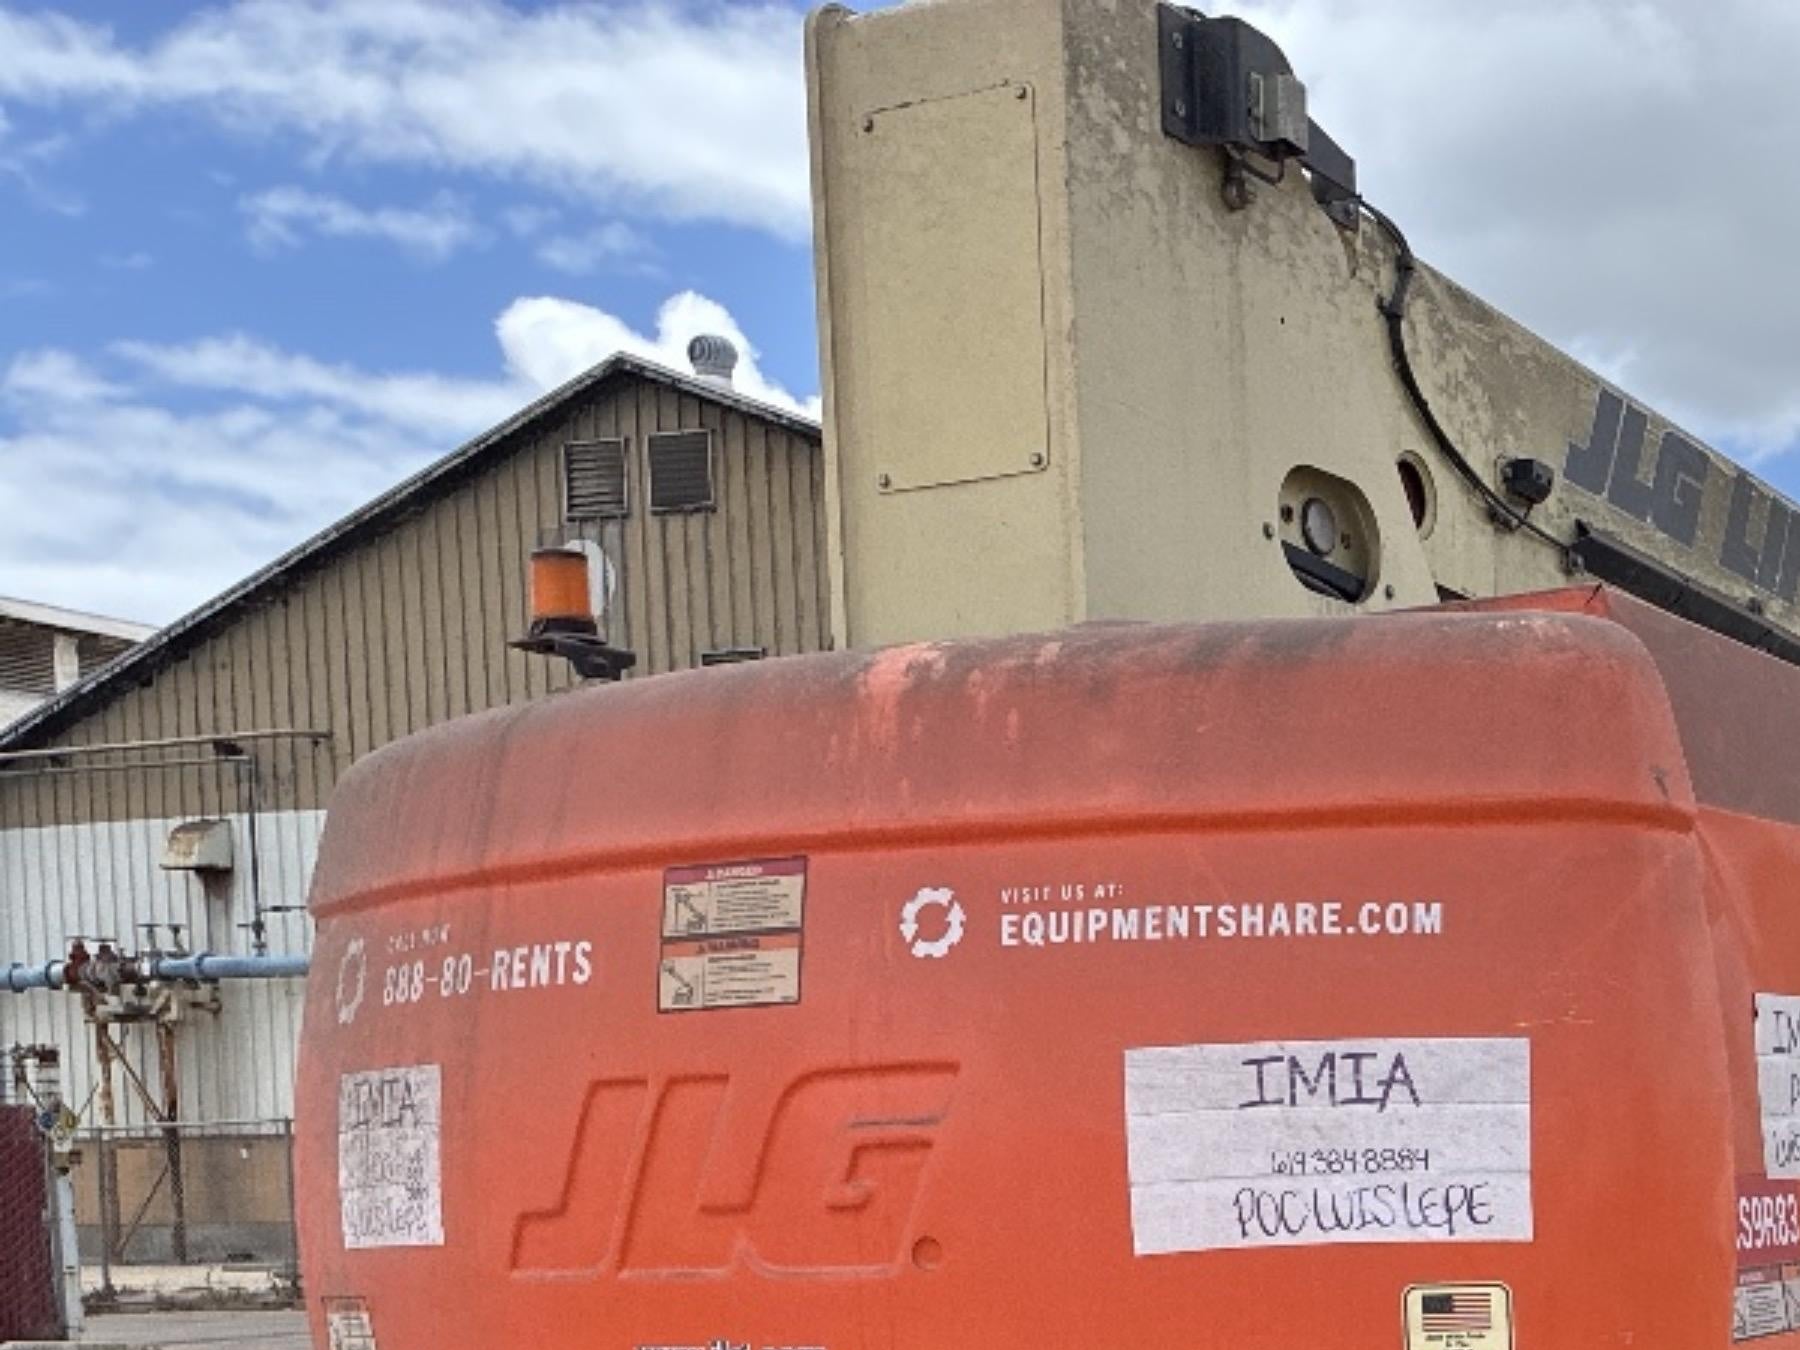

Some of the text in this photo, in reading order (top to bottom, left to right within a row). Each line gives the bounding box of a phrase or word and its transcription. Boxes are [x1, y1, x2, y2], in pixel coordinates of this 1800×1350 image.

[1563, 386, 1712, 550] JLG
[1001, 883, 1123, 903] VISIT US AT:
[1001, 901, 1443, 947] EQUIPMENTSHARE.COM
[383, 941, 593, 1006] 888-80-RENTS
[1239, 1050, 1421, 1112] IMIA
[509, 1060, 961, 1281] JLG
